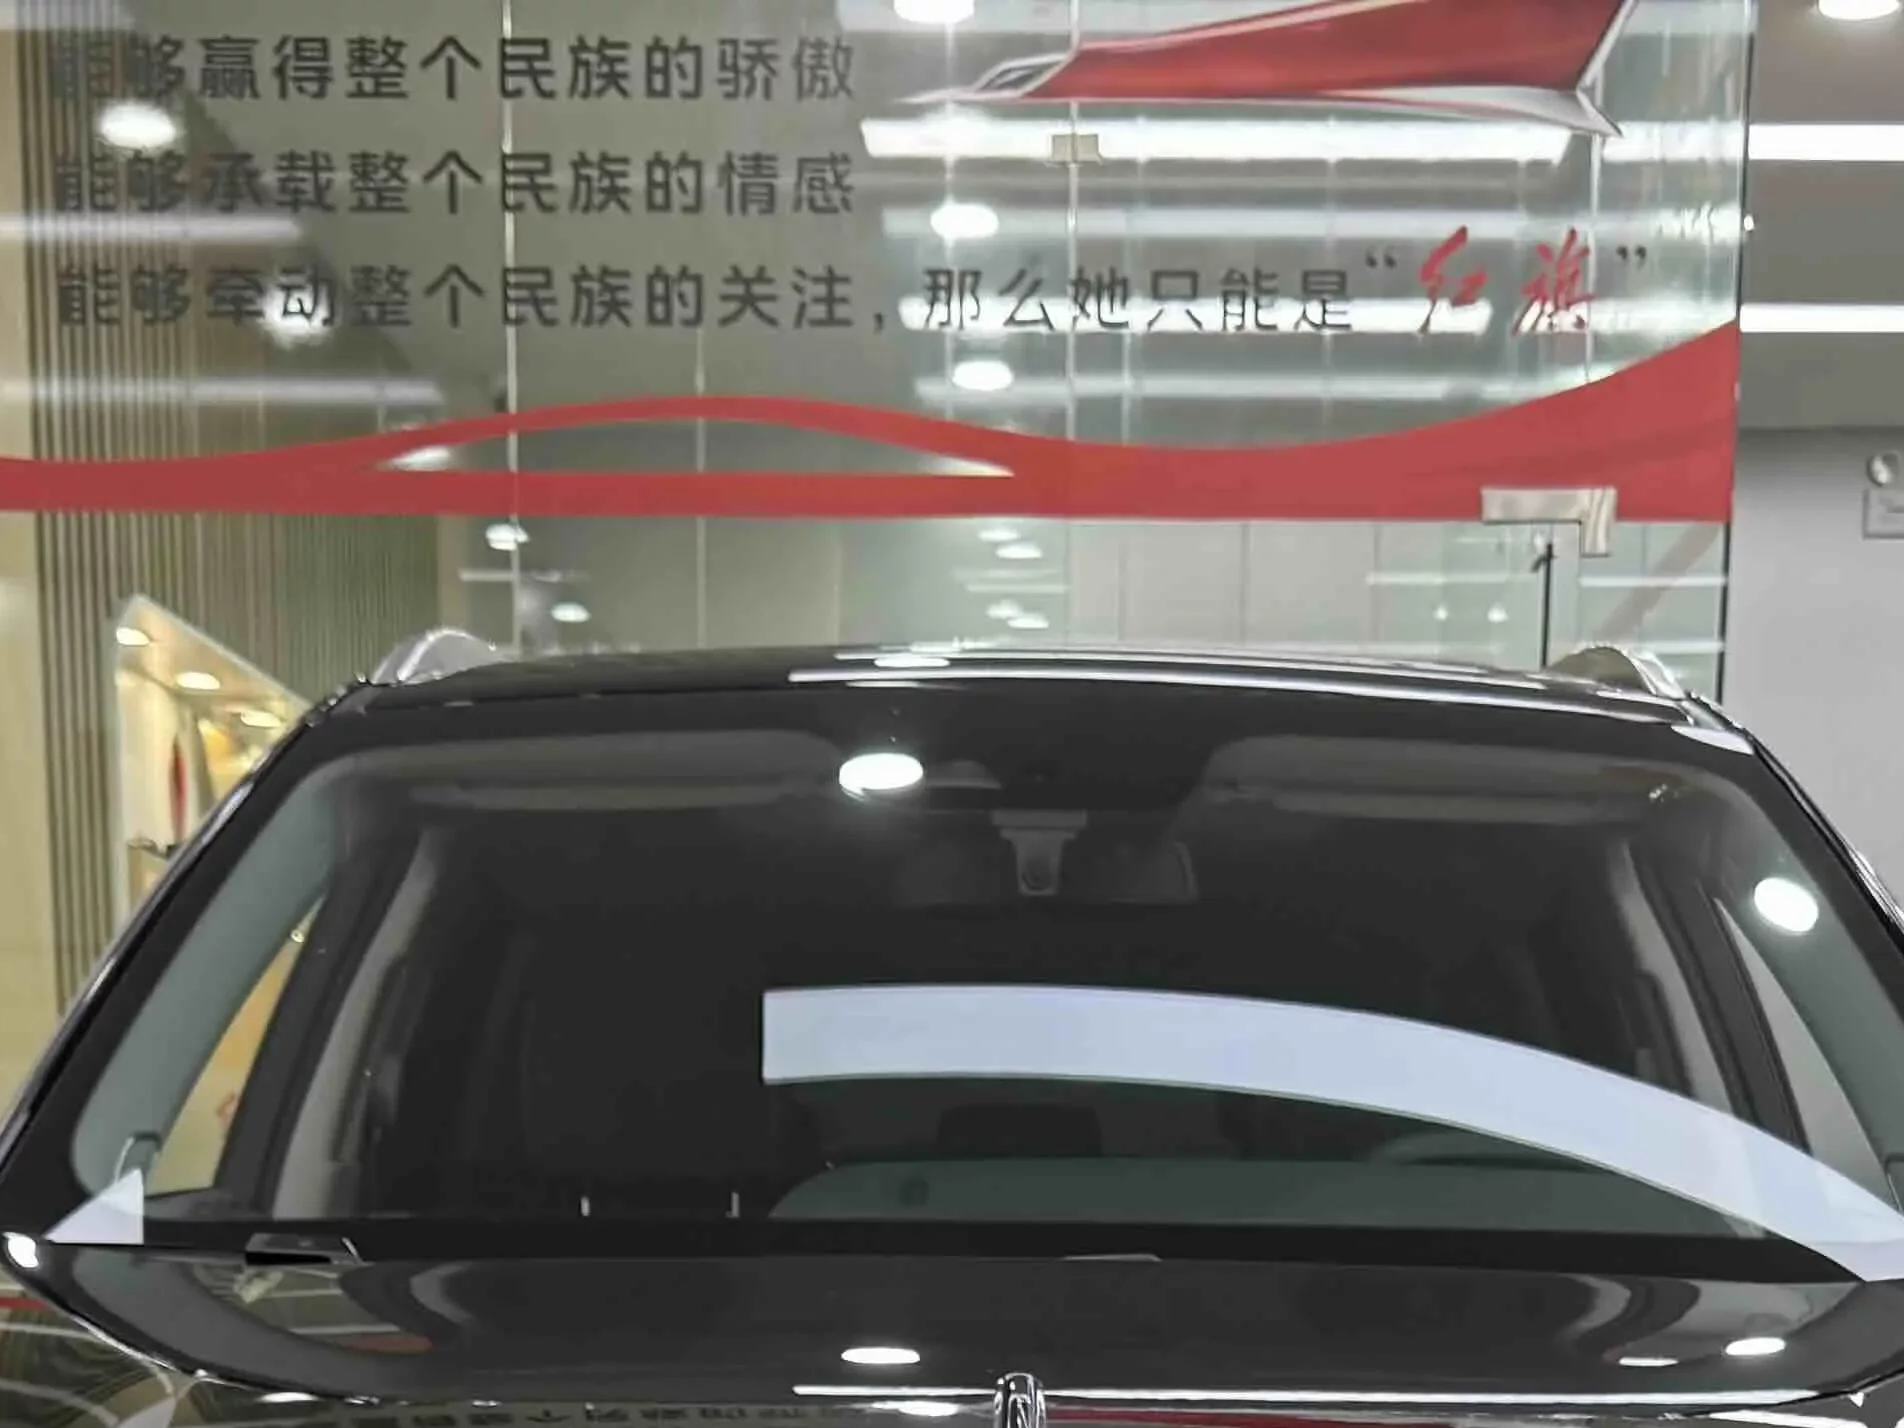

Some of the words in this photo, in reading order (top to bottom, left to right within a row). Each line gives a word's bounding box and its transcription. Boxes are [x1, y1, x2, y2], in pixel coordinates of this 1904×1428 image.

[51, 34, 854, 101] 能够赢得整个民族的骄傲
[54, 150, 854, 215] 能够承载整个民族的情感
